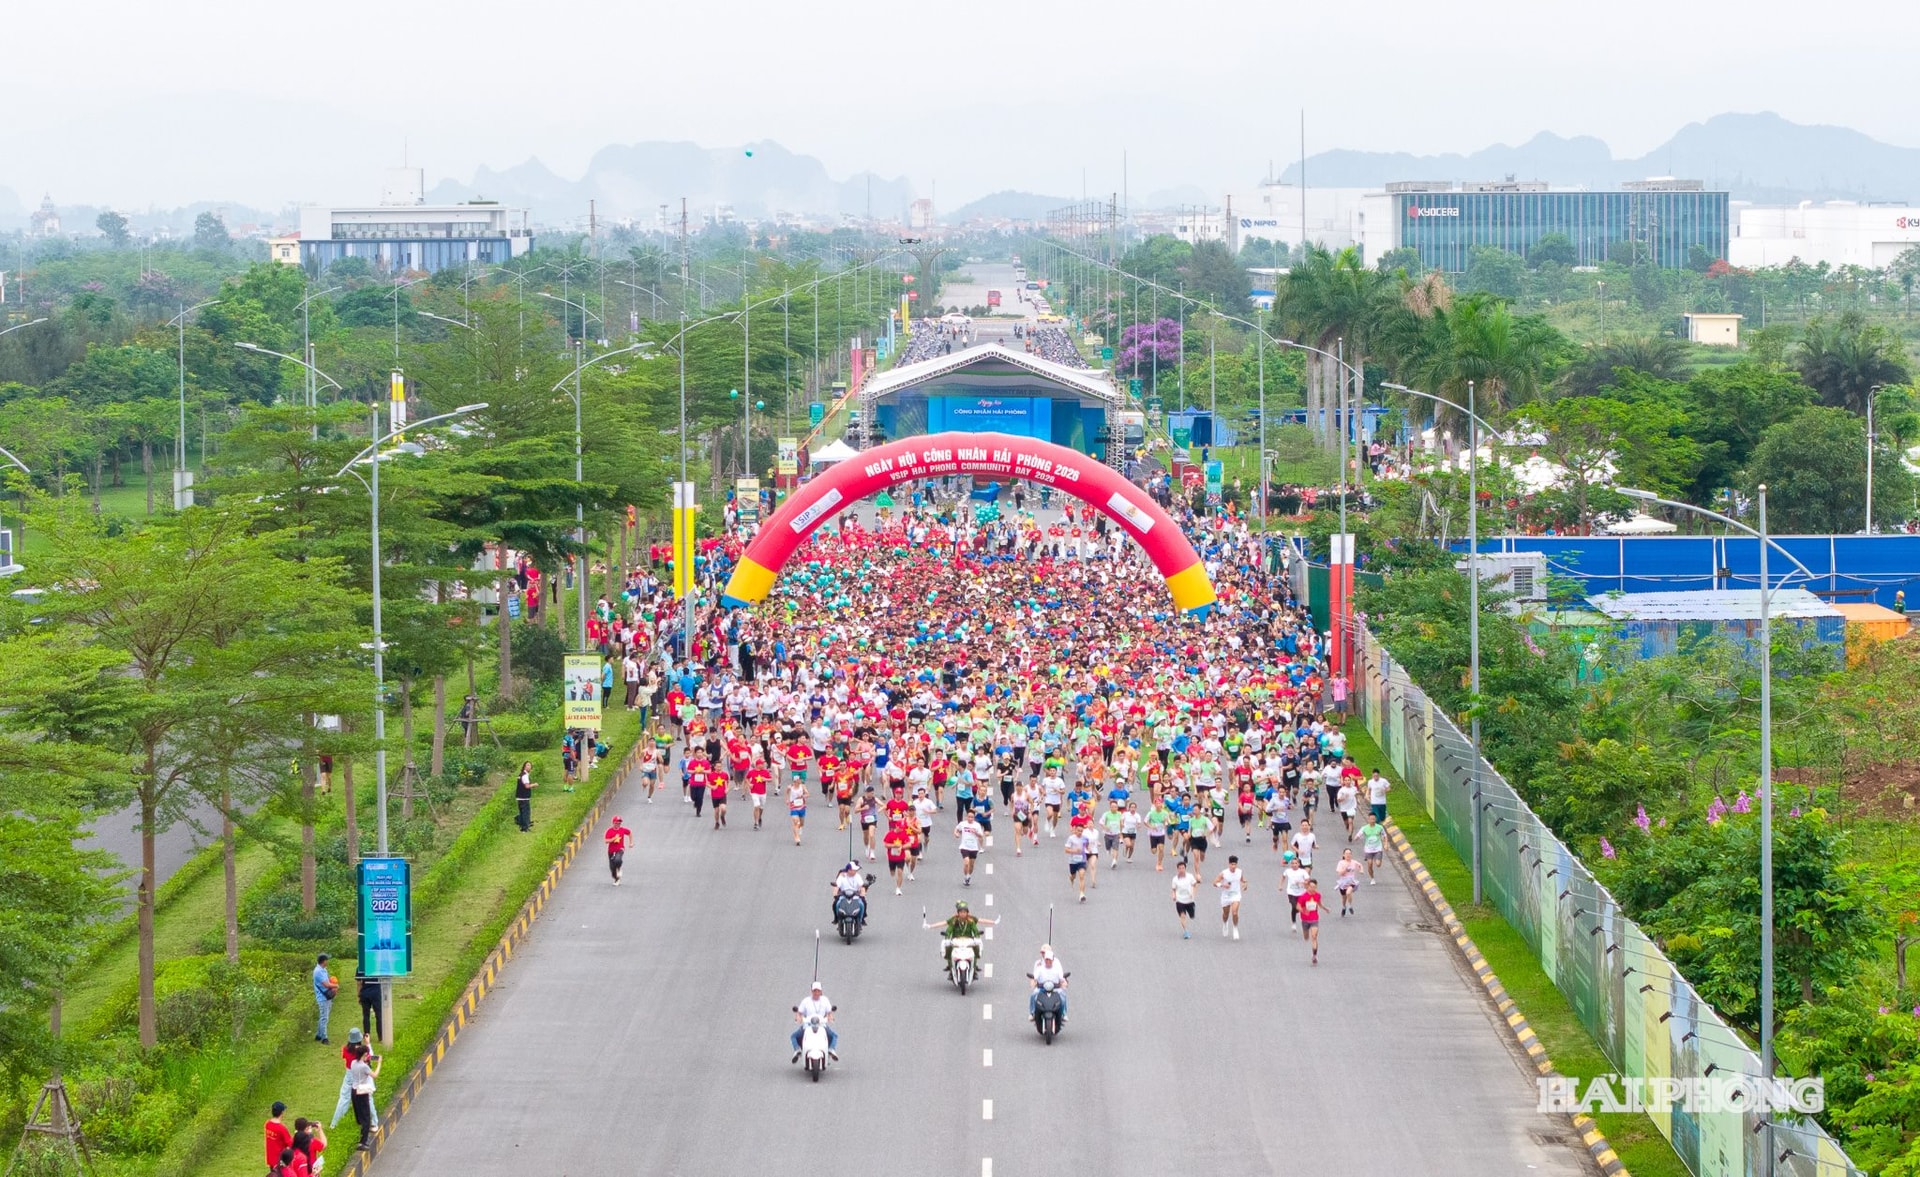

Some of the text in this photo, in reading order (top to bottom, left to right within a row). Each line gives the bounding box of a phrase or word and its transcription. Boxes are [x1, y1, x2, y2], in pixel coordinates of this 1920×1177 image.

[1418, 207, 1459, 217] KYOCERA
[865, 458, 893, 477] NGÀY
[898, 451, 917, 468] HỘI
[923, 448, 951, 463] CÔNG
[958, 447, 987, 461] NHÂN
[1017, 453, 1052, 472] PHÒNG
[1054, 464, 1080, 482] 2026
[890, 462, 1056, 483] VSIP HAI PHONG COMMUNITY DAY 2026
[372, 900, 397, 911] 2026
